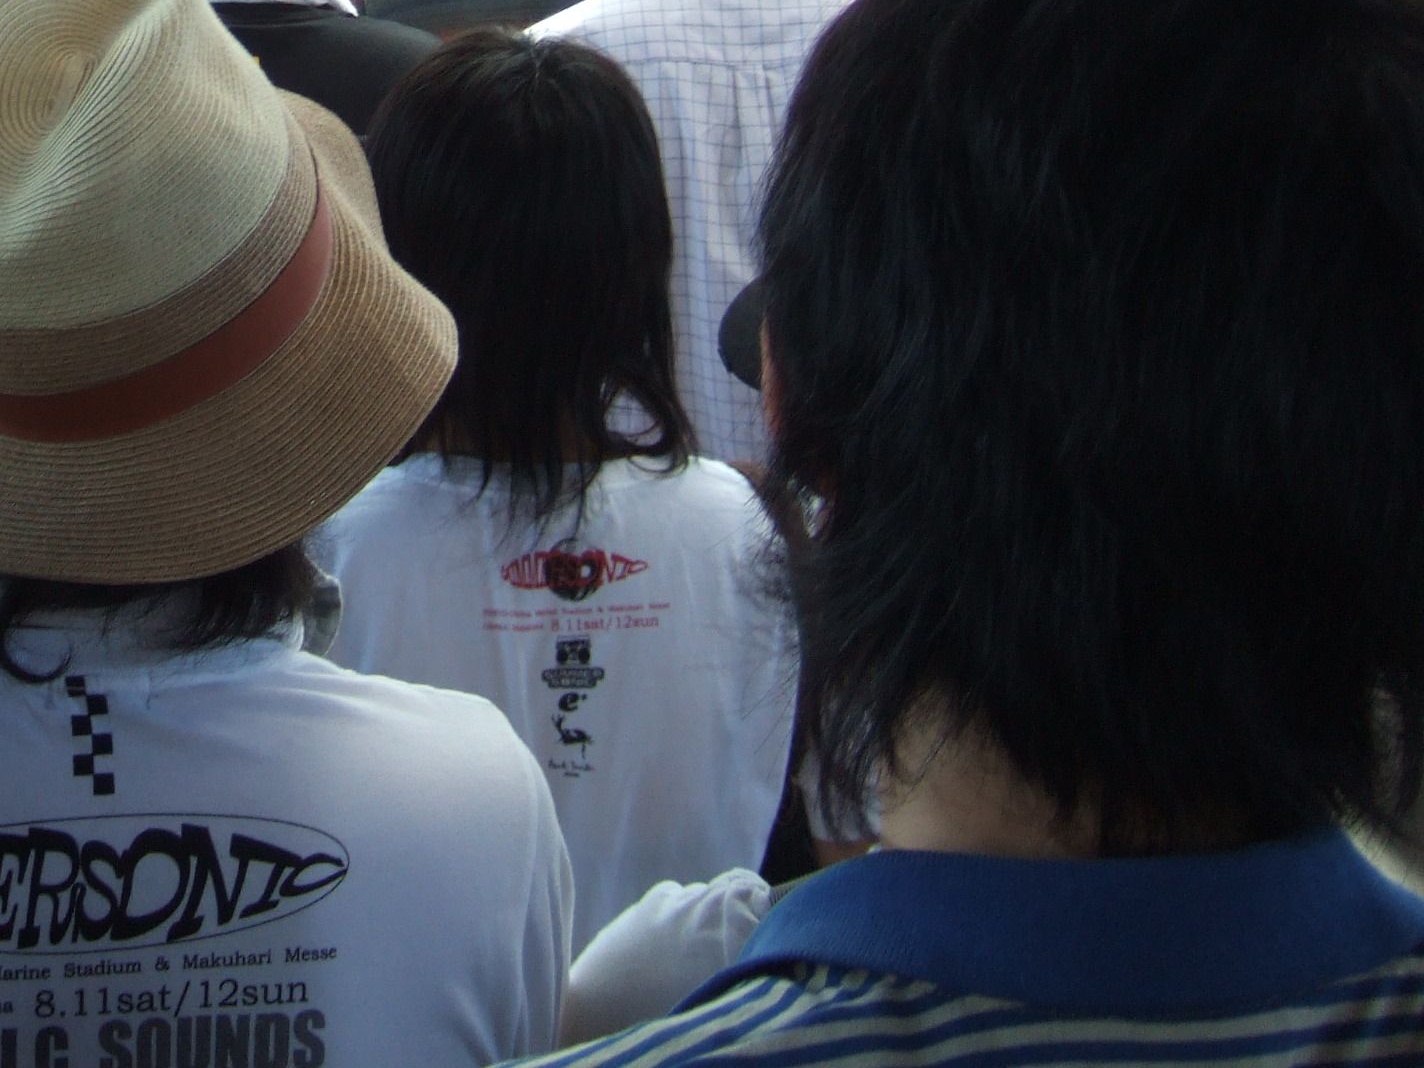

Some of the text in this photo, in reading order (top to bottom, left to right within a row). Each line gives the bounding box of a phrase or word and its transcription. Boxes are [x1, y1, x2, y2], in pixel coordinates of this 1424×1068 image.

[64, 958, 142, 978] Stadium
[154, 956, 171, 972] &
[183, 949, 272, 971] Makuhari
[285, 946, 338, 964] Messe
[35, 978, 309, 1019] 8.11sat/12sun
[98, 1009, 326, 1068] SOUNDS
